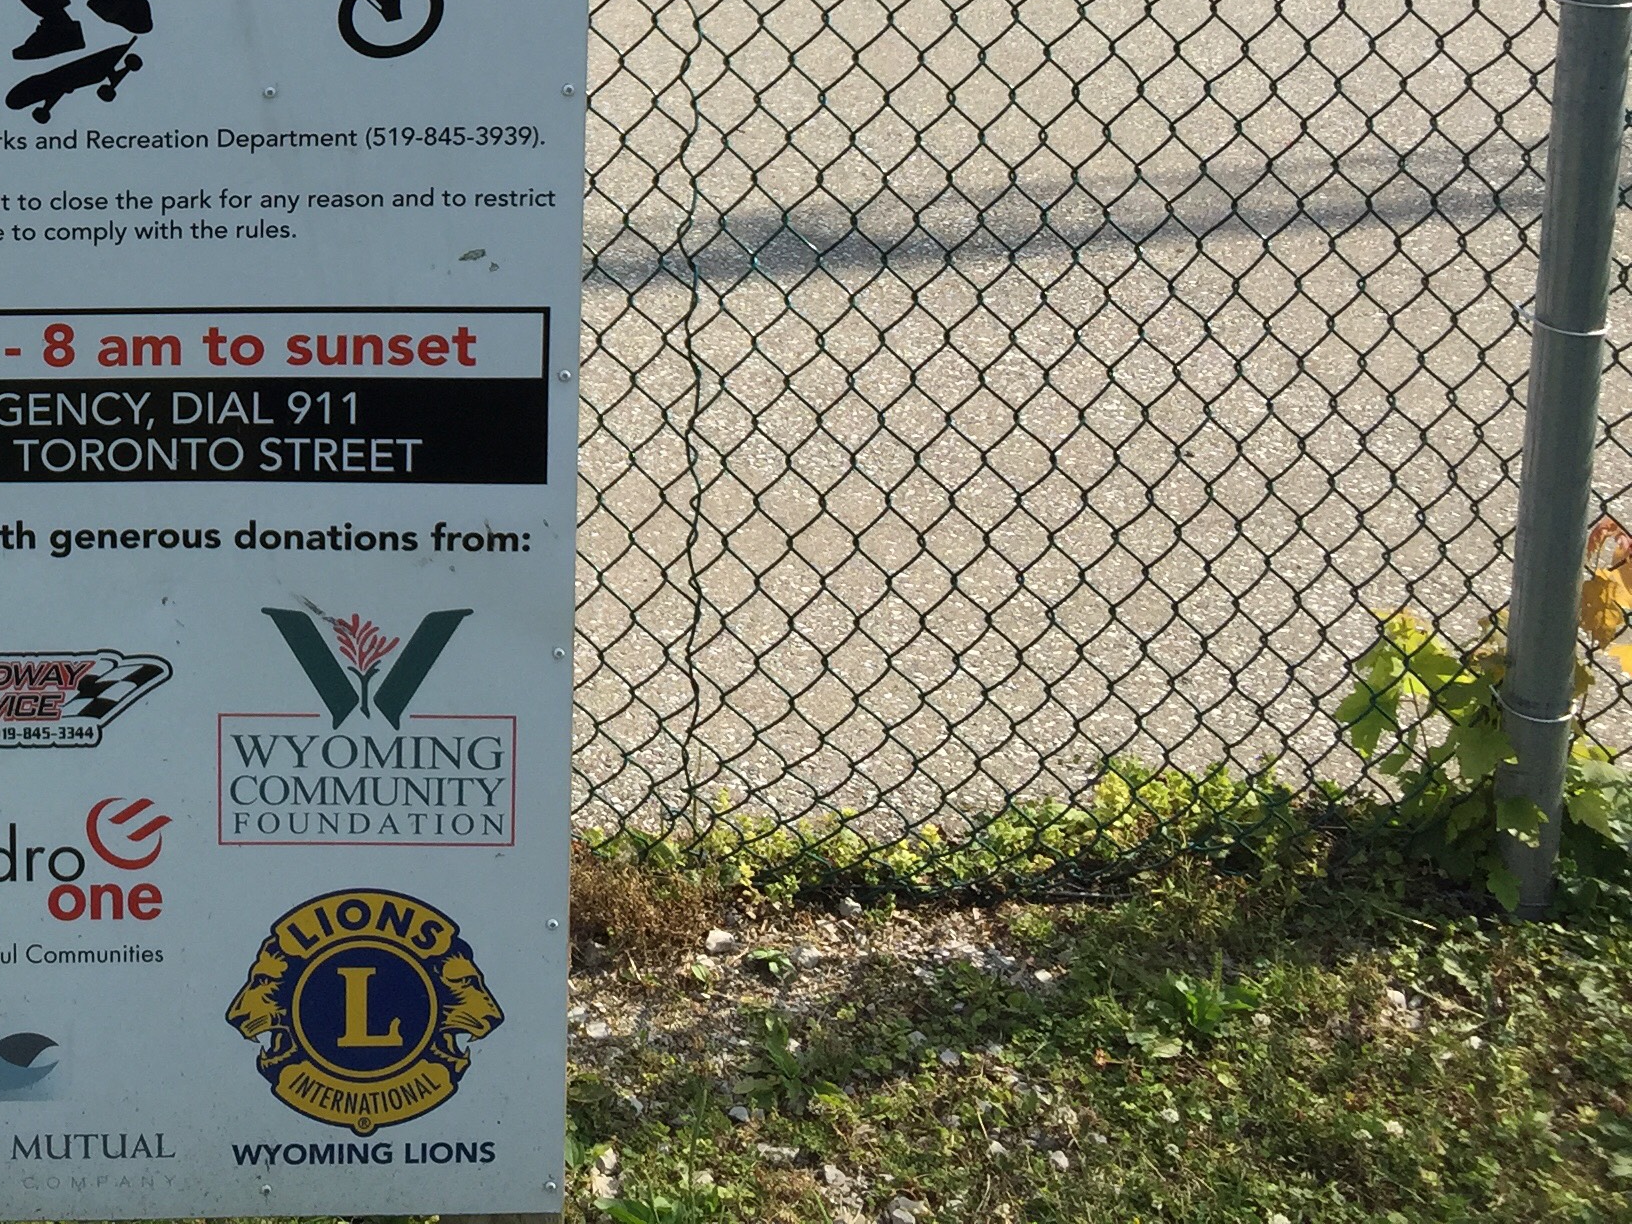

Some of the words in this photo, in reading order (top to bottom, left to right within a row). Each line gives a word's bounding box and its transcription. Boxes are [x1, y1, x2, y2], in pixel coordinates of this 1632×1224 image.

[36, 129, 77, 149] and
[87, 129, 208, 149] Recreation
[218, 129, 357, 154] Department
[366, 126, 545, 149] (519-845-3939).
[44, 324, 75, 367] 8
[98, 336, 181, 367] am
[203, 327, 264, 366] to
[287, 327, 476, 366] sunset
[173, 392, 274, 424] DIAL
[288, 391, 356, 424] 911
[13, 437, 243, 472] TORONTO
[260, 437, 422, 472] STREET
[50, 529, 221, 558] generous
[235, 520, 418, 551] donations
[431, 522, 530, 552] from:
[230, 734, 504, 770] WYOMING
[230, 774, 506, 806] COMMUNITY
[233, 812, 504, 836] FOUNDATION
[48, 881, 163, 922] one
[287, 898, 444, 951] LIONS
[26, 944, 163, 963] Communities
[337, 967, 403, 1047] L
[288, 1072, 441, 1116] INTERNATIONAL
[10, 1133, 176, 1160] MUTUAL
[231, 1143, 393, 1165] WYOMING
[405, 1141, 496, 1164] LIONS
